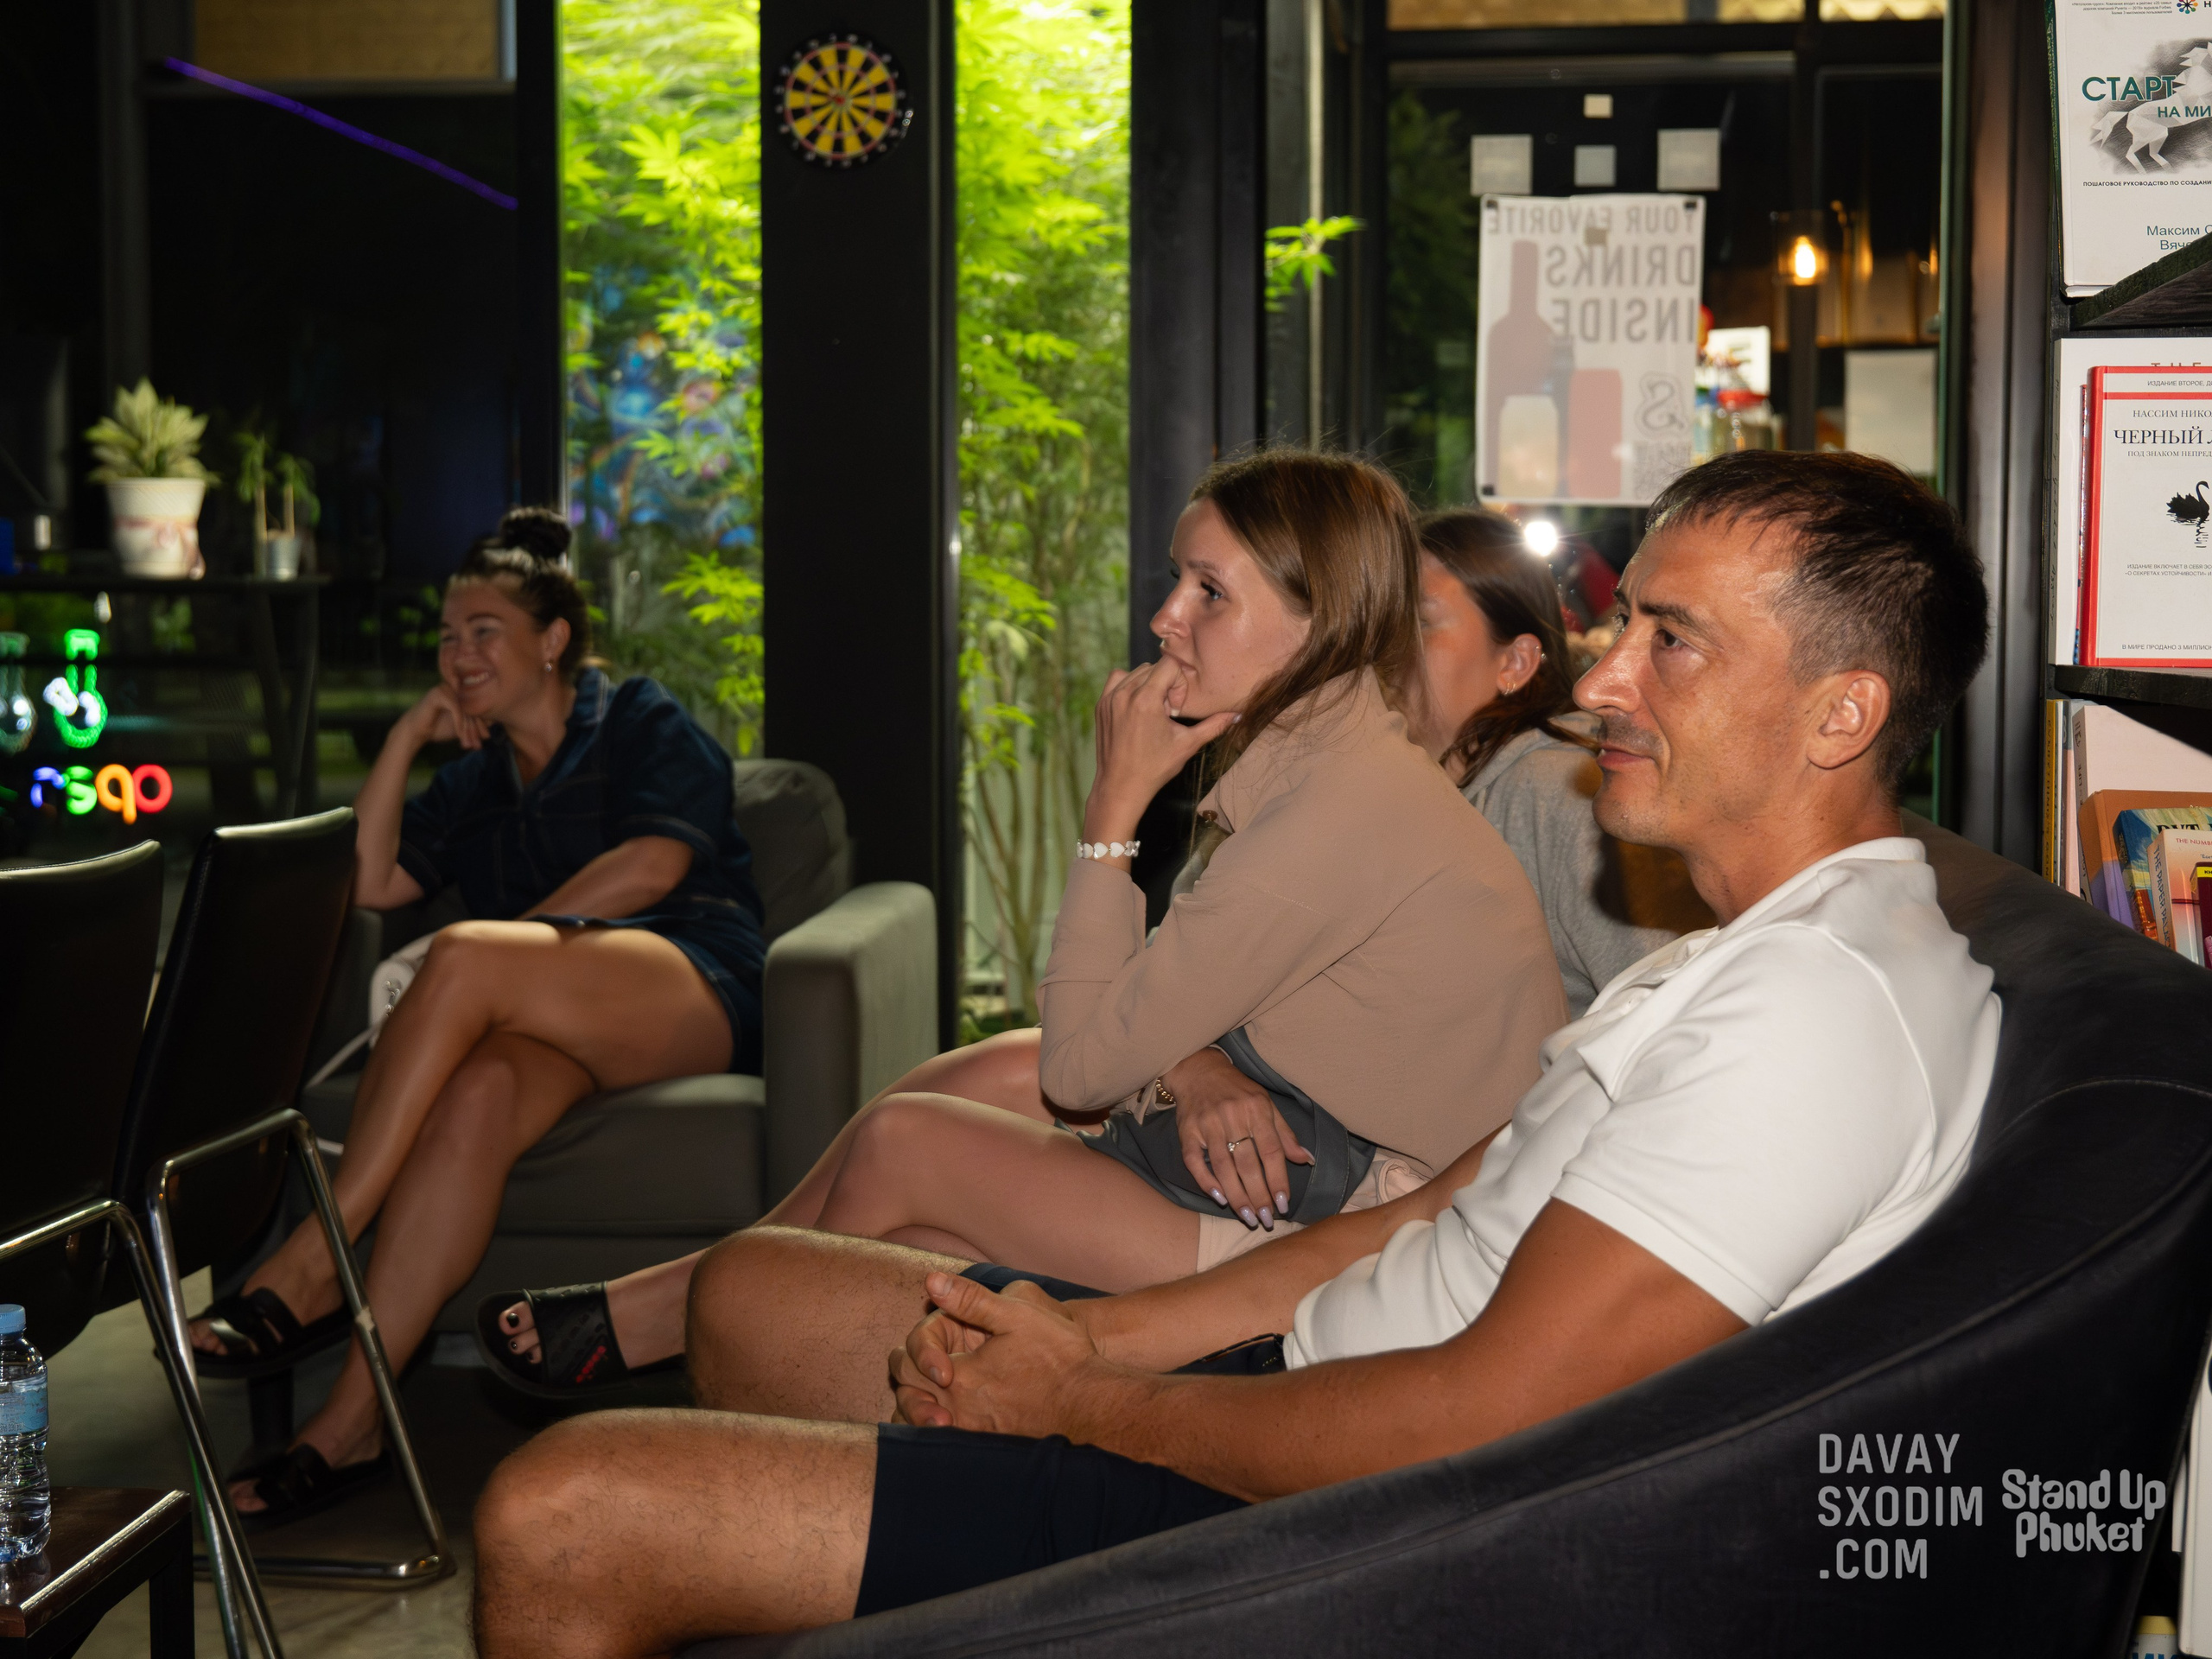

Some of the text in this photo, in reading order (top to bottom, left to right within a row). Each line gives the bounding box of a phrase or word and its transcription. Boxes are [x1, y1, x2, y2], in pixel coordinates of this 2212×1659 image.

[2082, 75, 2176, 102] СТАРТ
[2158, 105, 2181, 118] НА
[2146, 225, 2200, 236] Максим
[2113, 425, 2203, 444] ЧЕРНЫЙ
[2153, 845, 2162, 871] THE
[2157, 870, 2166, 908] PAPER
